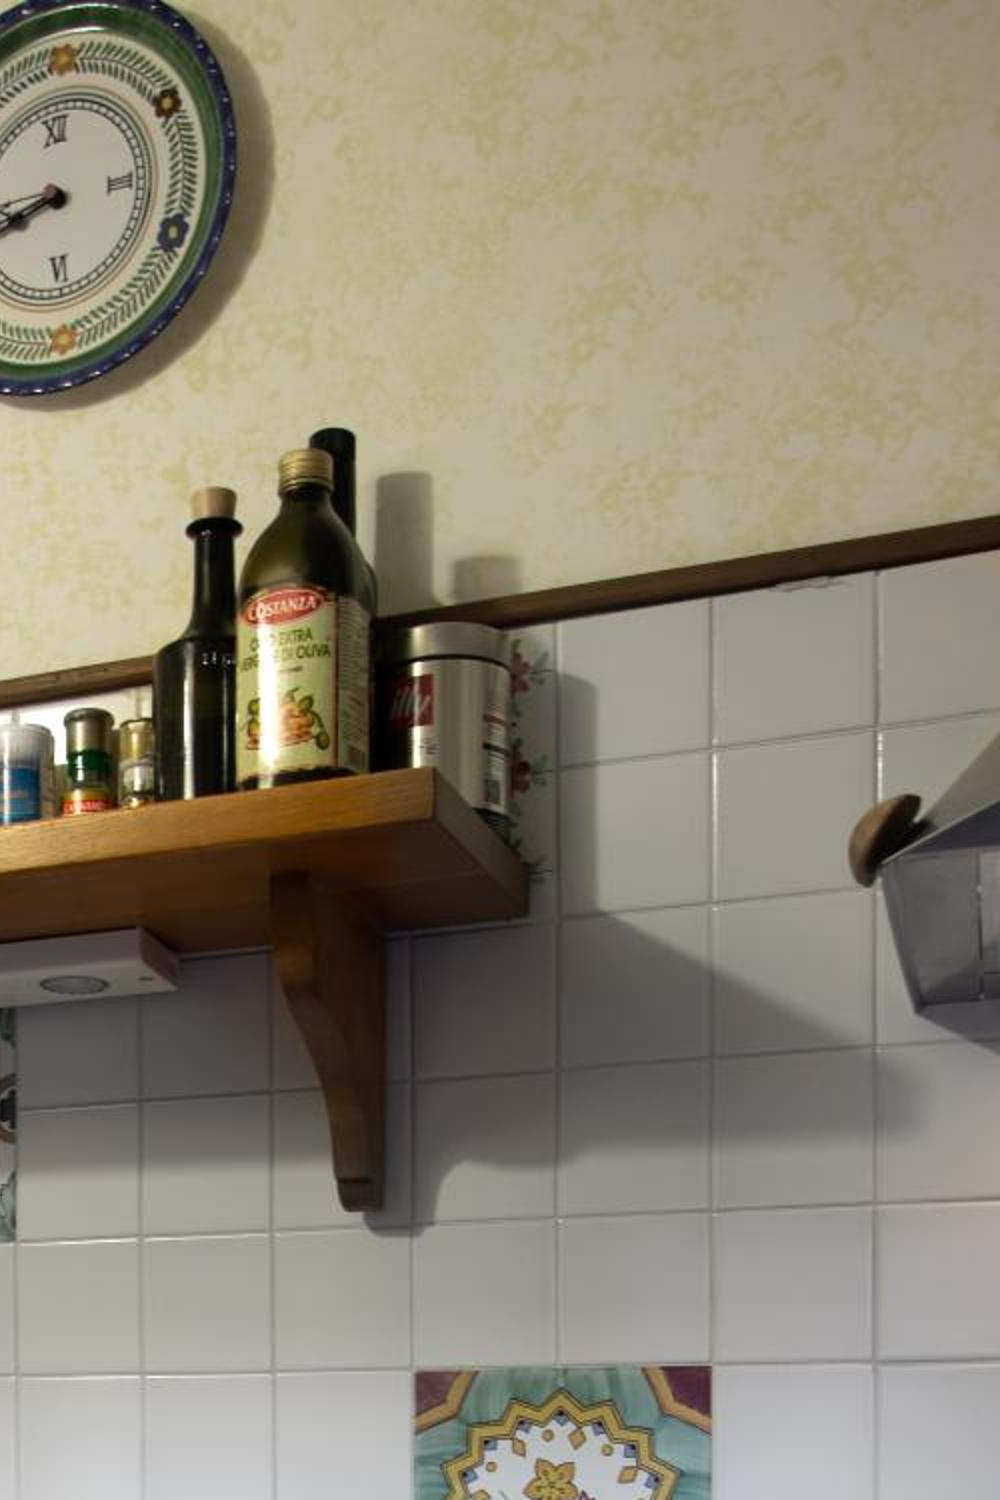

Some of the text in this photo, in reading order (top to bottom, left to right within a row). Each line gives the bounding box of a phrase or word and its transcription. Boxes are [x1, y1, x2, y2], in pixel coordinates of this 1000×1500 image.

[43, 114, 69, 148] XII
[106, 172, 133, 195] III
[49, 254, 69, 283] VI
